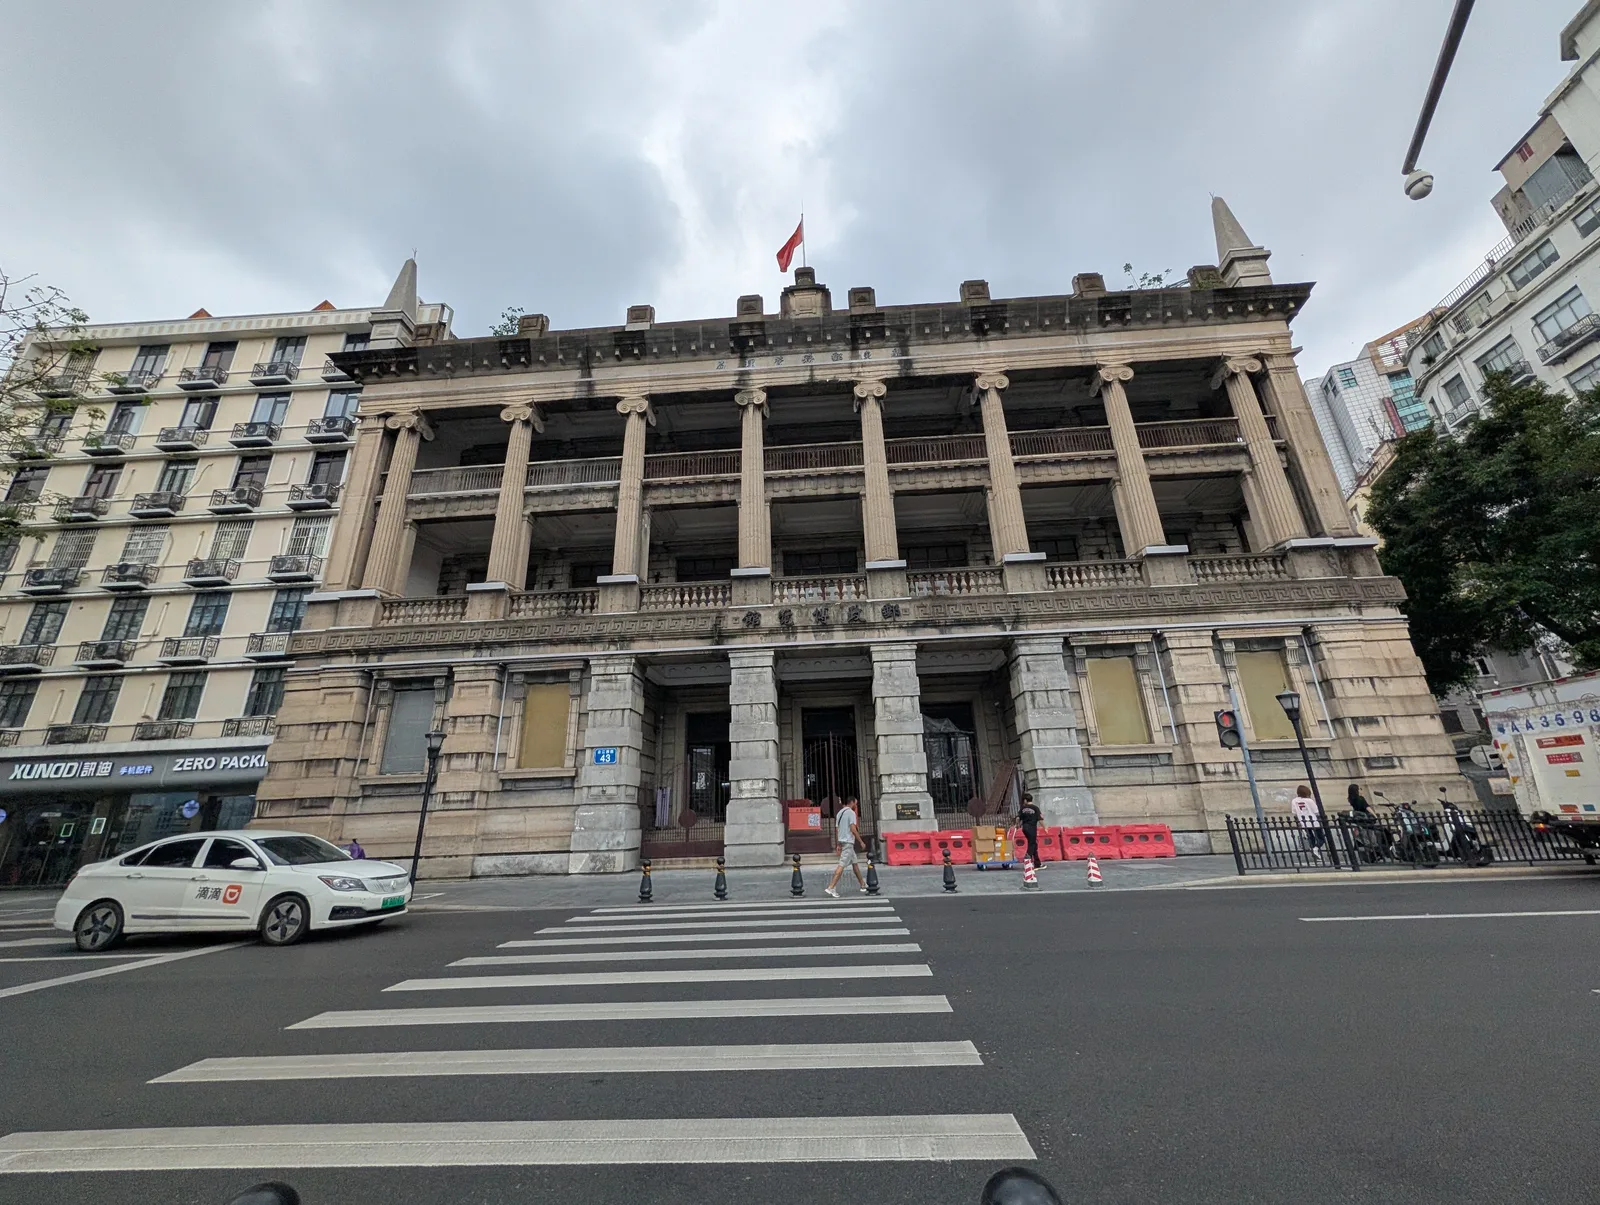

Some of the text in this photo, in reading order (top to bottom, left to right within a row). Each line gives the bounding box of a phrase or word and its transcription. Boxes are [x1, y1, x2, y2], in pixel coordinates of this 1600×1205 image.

[173, 754, 268, 771] ZERO PACKI
[600, 754, 611, 762] 43
[80, 761, 113, 777] 訊迪
[119, 765, 153, 775] 手机配件
[195, 886, 223, 900] 滴滴
